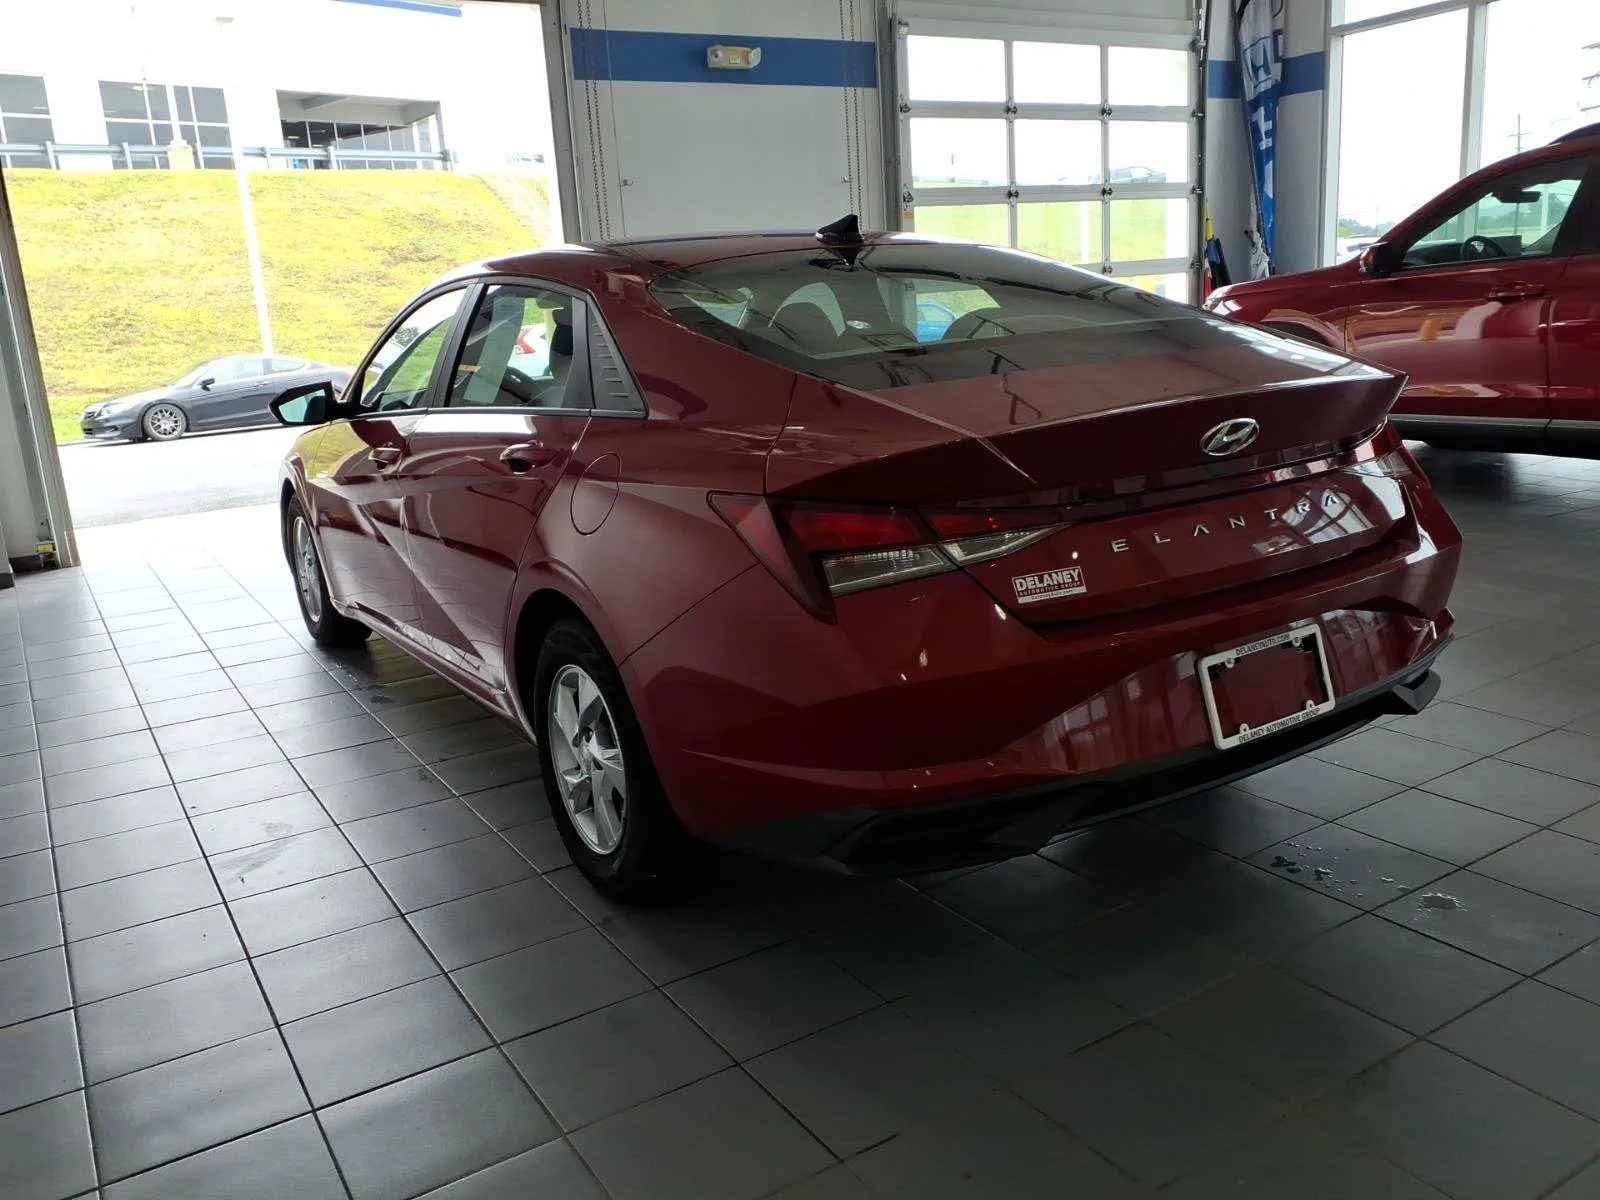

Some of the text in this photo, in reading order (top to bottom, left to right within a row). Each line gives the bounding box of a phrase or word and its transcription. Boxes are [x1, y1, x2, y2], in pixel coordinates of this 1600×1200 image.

[1111, 494, 1340, 553] ELANTRA
[1015, 569, 1079, 591] DELANEY
[1239, 707, 1321, 742] DELANEY AUTOMOTIVE GROUP
